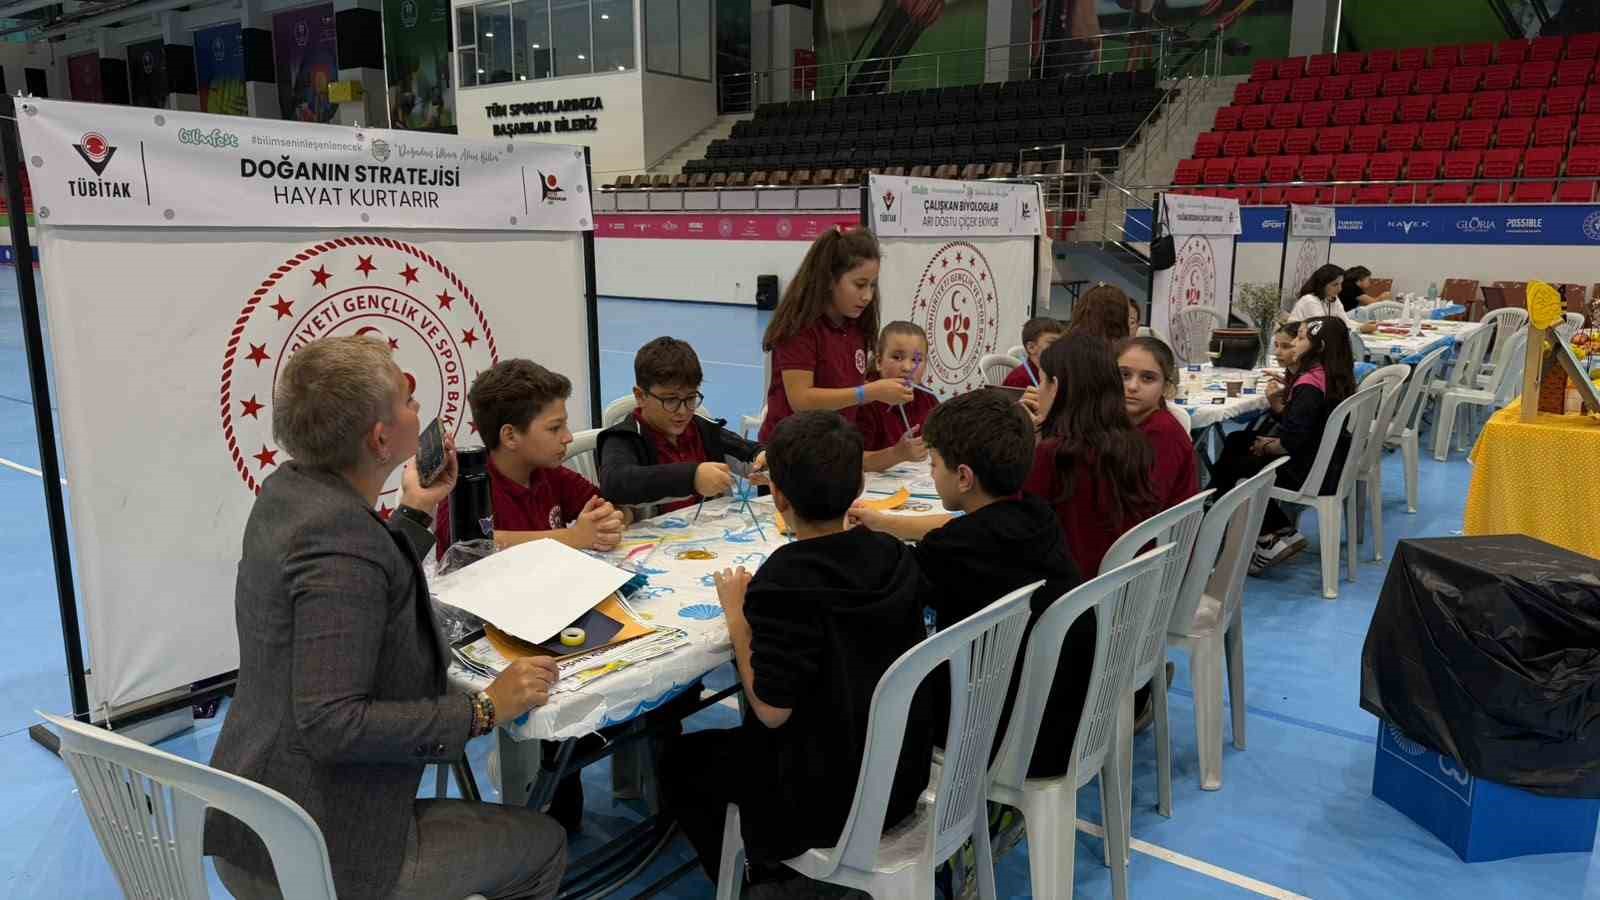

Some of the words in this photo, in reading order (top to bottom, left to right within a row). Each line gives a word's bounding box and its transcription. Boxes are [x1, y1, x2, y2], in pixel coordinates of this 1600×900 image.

[485, 102, 507, 118] TÜM
[509, 96, 603, 116] SPORCULARIMIZA
[493, 120, 552, 138] BAŞARILAR
[240, 155, 350, 182] DOĞANIN
[355, 164, 461, 187] STRATEJİSİ
[68, 177, 131, 198] TÜBİTAK
[274, 186, 343, 206] HAYAT
[350, 188, 440, 209] KURTARIR
[924, 199, 958, 214] ÇALIŞKAN
[1456, 216, 1496, 229] GLORIA
[343, 295, 418, 321] GENÇLİK
[420, 316, 440, 339] VE
[435, 339, 459, 385] SPOR
